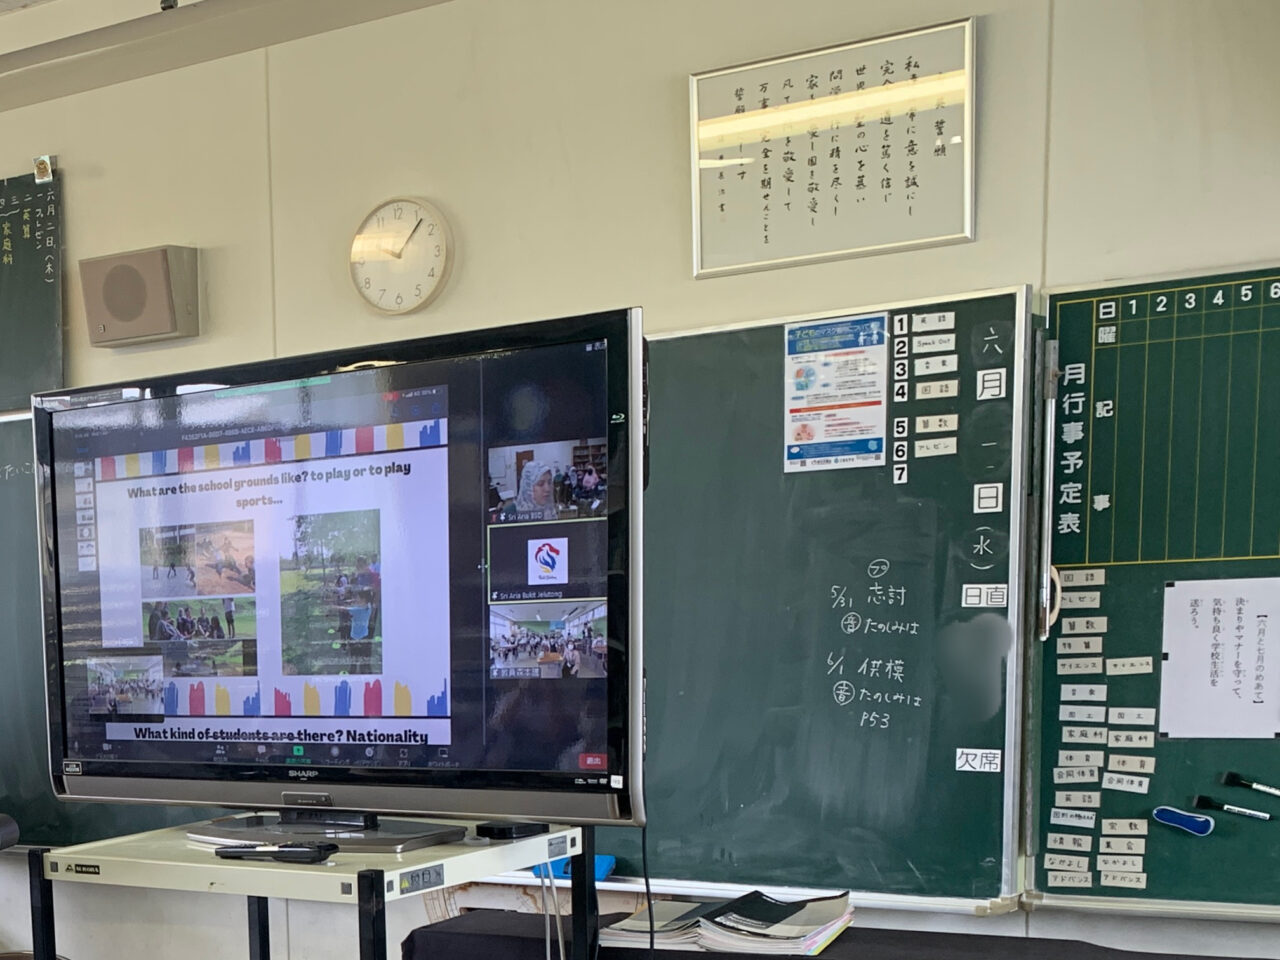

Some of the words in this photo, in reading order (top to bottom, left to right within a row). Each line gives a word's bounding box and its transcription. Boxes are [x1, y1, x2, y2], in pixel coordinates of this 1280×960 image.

[393, 207, 403, 220] 12
[428, 223, 435, 236] 2
[434, 245, 441, 258] 3
[428, 267, 435, 278] 4
[364, 277, 371, 290] 8
[414, 284, 421, 297] 5
[379, 288, 386, 302] 7
[395, 292, 403, 305] 6
[1099, 301, 1116, 319] 日
[1129, 299, 1137, 315] 1
[1156, 296, 1167, 312] 2
[1185, 293, 1196, 309] 3
[1212, 289, 1224, 306] 4
[1240, 285, 1253, 301] 5
[1270, 282, 1280, 298] 6
[898, 317, 904, 332] 1
[1097, 325, 1117, 344] 曜
[896, 340, 907, 355] 2
[896, 362, 907, 377] 3
[895, 384, 906, 399] 4
[895, 420, 906, 435] 5
[895, 444, 906, 459] 6
[1057, 362, 1086, 534] 月行事予定表
[127, 486, 158, 499] What
[158, 484, 178, 496] are
[178, 481, 197, 494] the
[198, 478, 233, 492] school
[234, 474, 280, 492] grounds
[281, 470, 309, 485] like?
[311, 471, 324, 482] to
[325, 468, 352, 483] play
[353, 467, 368, 478] or
[369, 465, 383, 476] to
[384, 461, 412, 478] play
[895, 467, 906, 481] 7
[235, 494, 284, 510] sports...
[964, 586, 1006, 607] 日直
[133, 727, 168, 741] What
[170, 727, 195, 740] kind
[196, 727, 211, 740] of
[211, 728, 270, 742] students
[272, 730, 297, 742] are
[297, 729, 343, 743] there?
[346, 729, 429, 745] Nationality
[957, 750, 1000, 771] 欠席
[288, 769, 319, 778] SHARP
